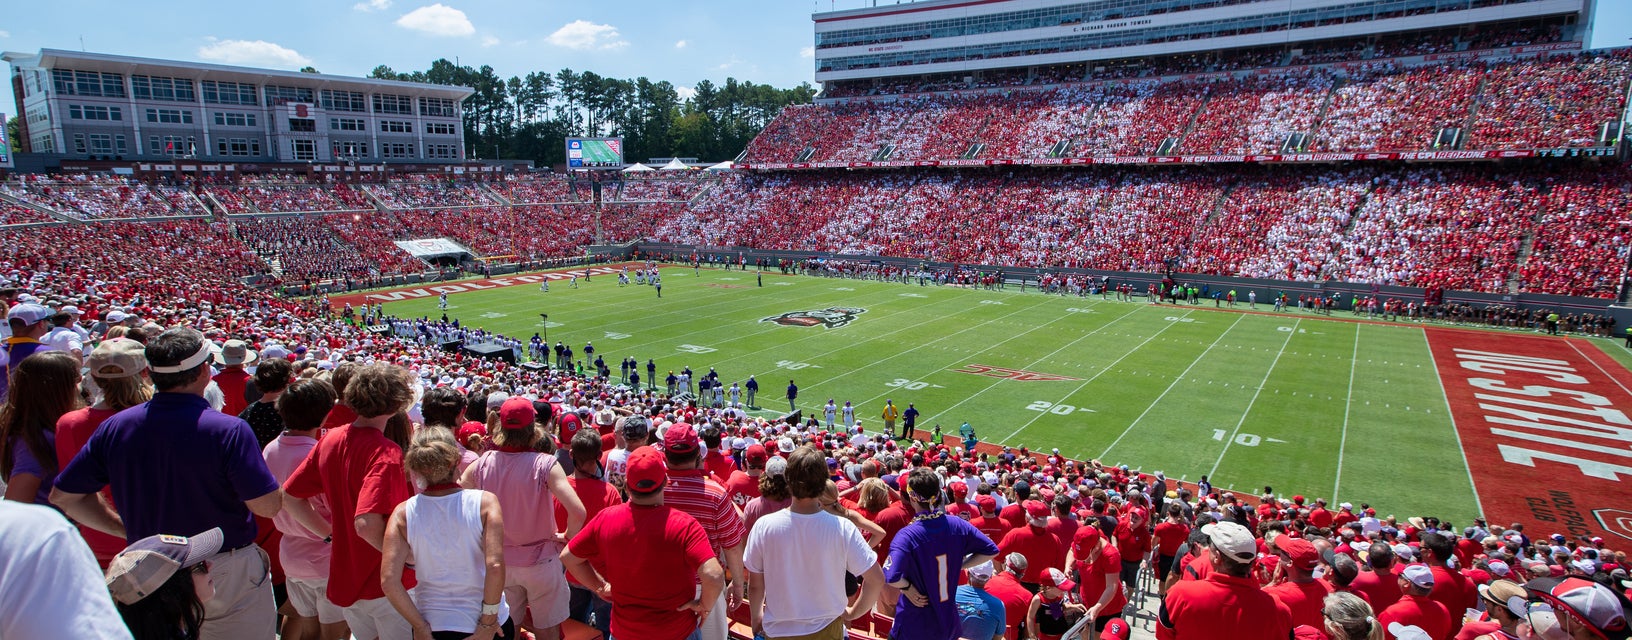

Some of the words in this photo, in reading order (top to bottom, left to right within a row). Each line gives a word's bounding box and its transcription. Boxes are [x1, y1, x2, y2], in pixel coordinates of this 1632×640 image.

[1398, 151, 1417, 160] THE
[369, 266, 620, 302] WOLFPACK
[1452, 347, 1590, 384] NC
[884, 378, 930, 391] 30
[1025, 400, 1076, 416] 20
[1211, 428, 1262, 447] 10
[1525, 497, 1557, 523] CLUB
[1548, 489, 1592, 540] WOLFPAC
[935, 553, 949, 603] 1
